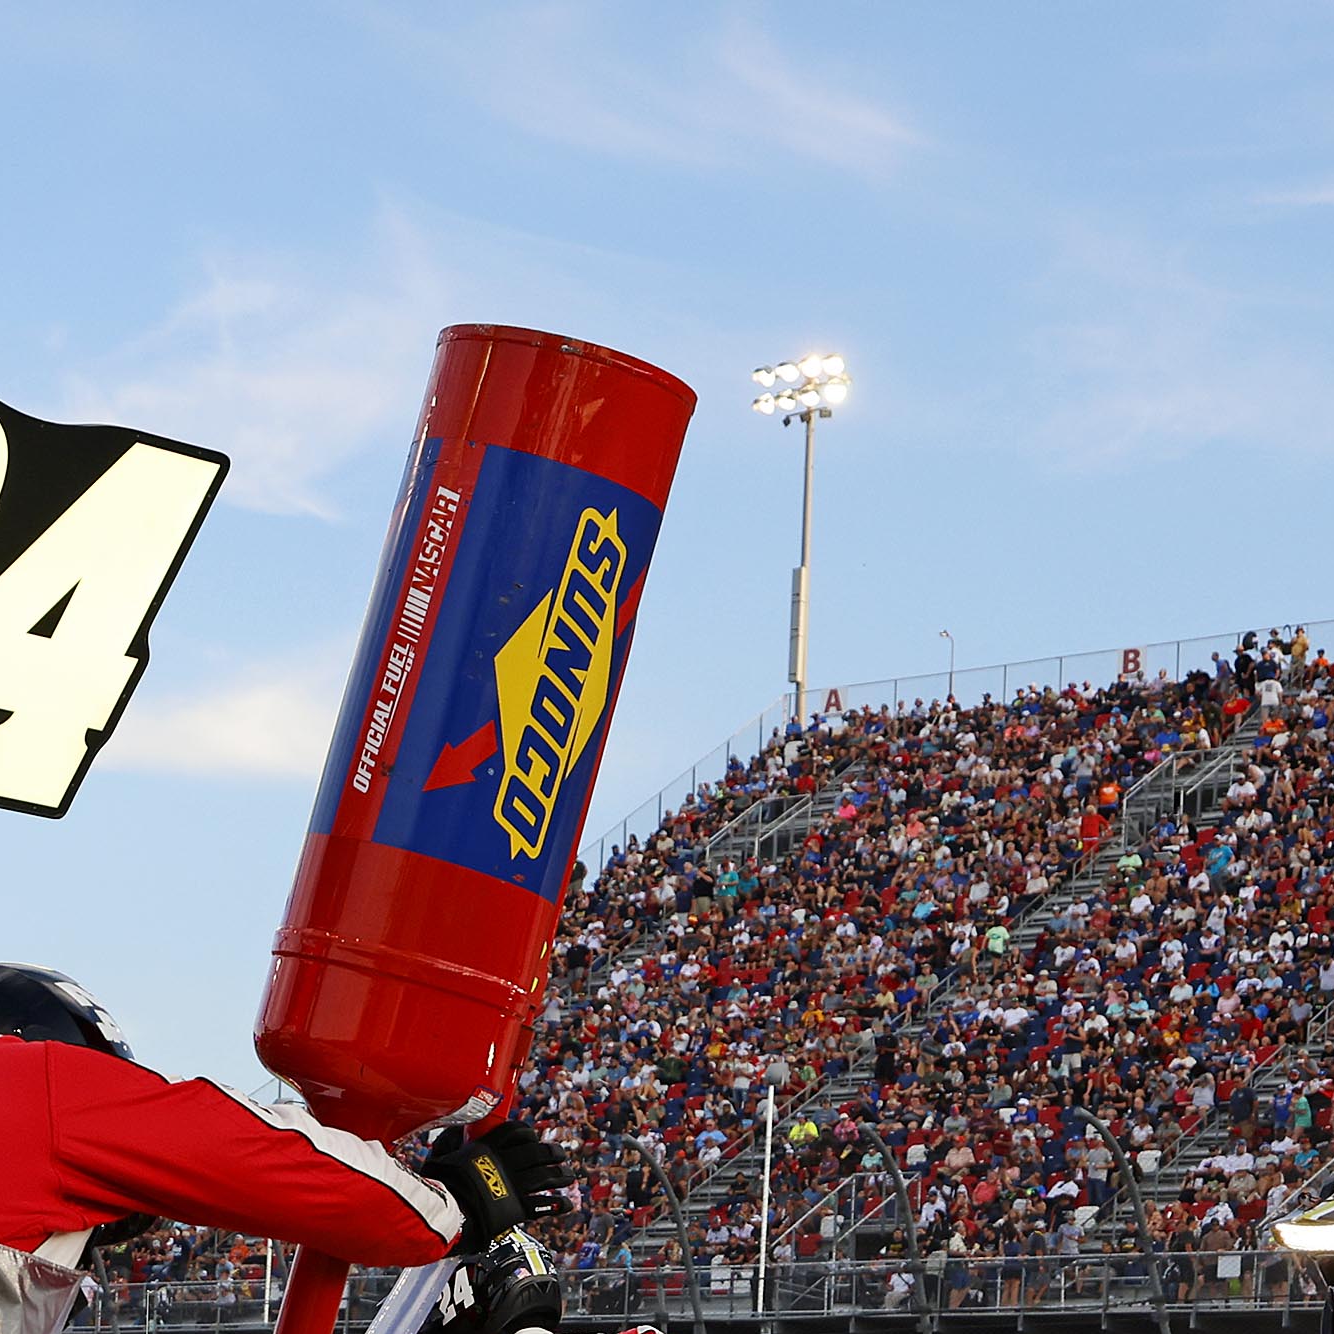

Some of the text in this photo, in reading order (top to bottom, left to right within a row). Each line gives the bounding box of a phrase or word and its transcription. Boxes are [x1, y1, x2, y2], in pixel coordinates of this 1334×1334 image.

[413, 486, 462, 591] NASCAR
[499, 513, 623, 851] SUNOCO
[824, 689, 843, 713] A
[1123, 649, 1141, 674] B
[353, 643, 410, 793] OFFICIAL FUEL
[436, 1266, 475, 1321] 24
